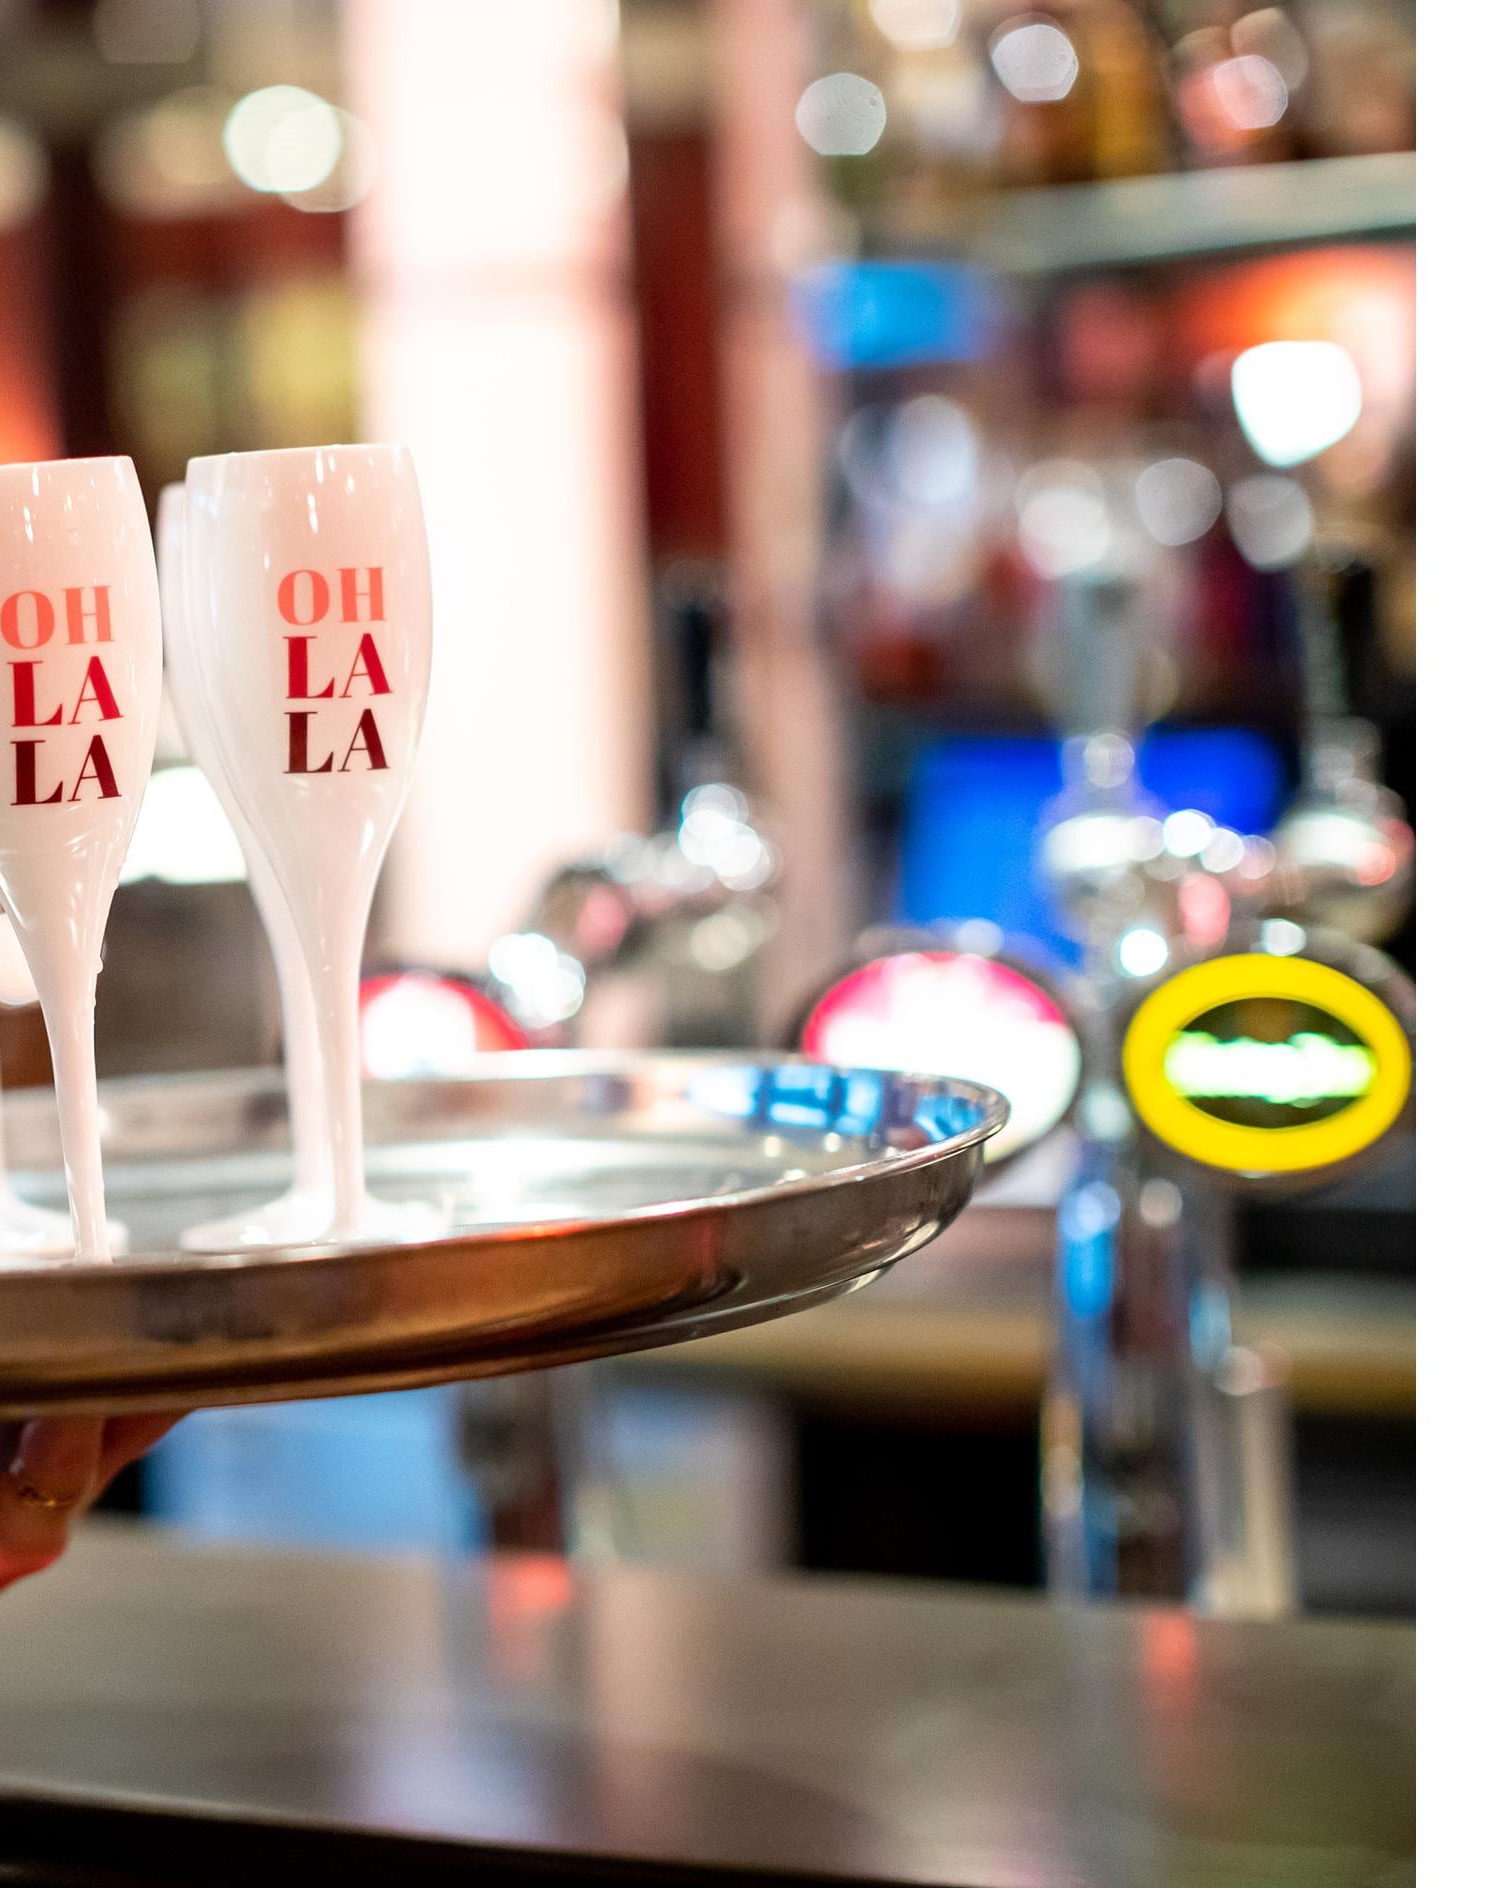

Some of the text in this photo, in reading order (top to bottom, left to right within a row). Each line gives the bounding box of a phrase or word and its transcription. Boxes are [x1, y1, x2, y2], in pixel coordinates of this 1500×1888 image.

[0, 585, 115, 650] OH
[276, 565, 387, 626] OH
[7, 655, 124, 728] LA
[282, 632, 393, 700] LA
[9, 734, 122, 807] LA
[283, 708, 390, 774] LA
